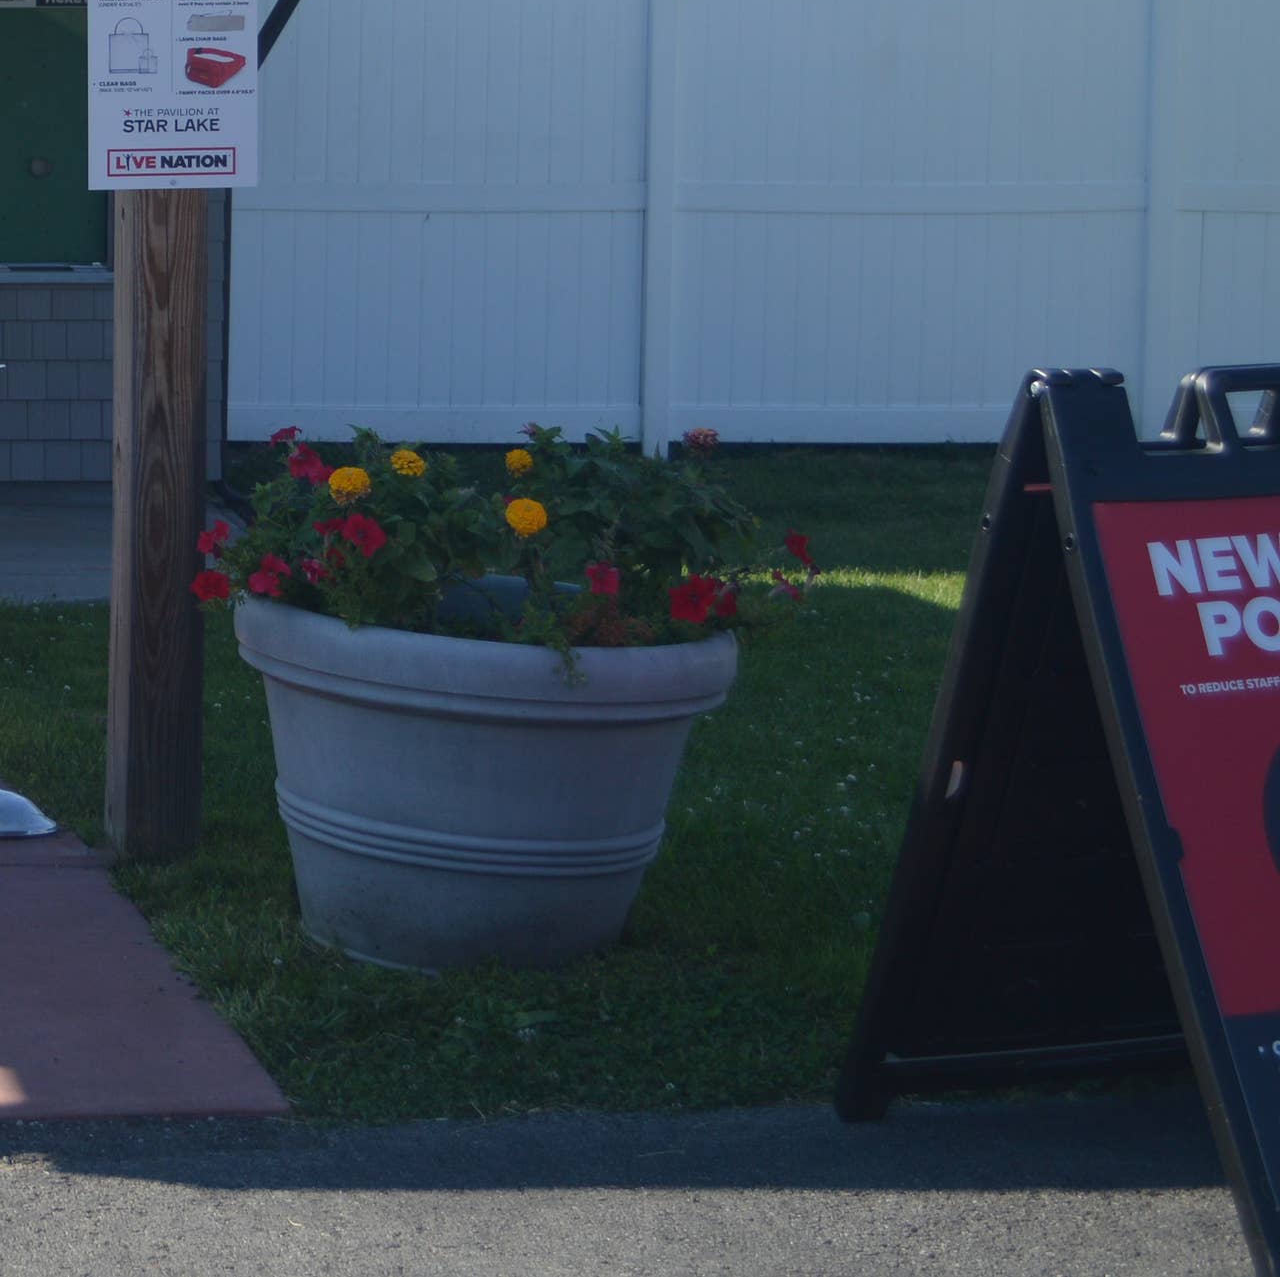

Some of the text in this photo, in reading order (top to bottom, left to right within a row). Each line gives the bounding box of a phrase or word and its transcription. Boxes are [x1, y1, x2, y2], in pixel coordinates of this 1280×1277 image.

[157, 108, 204, 116] PAVILION
[123, 118, 220, 133] STAR LAKE
[116, 154, 227, 171] LIVE NATION
[1146, 532, 1280, 596] NEW
[1180, 675, 1280, 695] TO REDUCE STAFF
